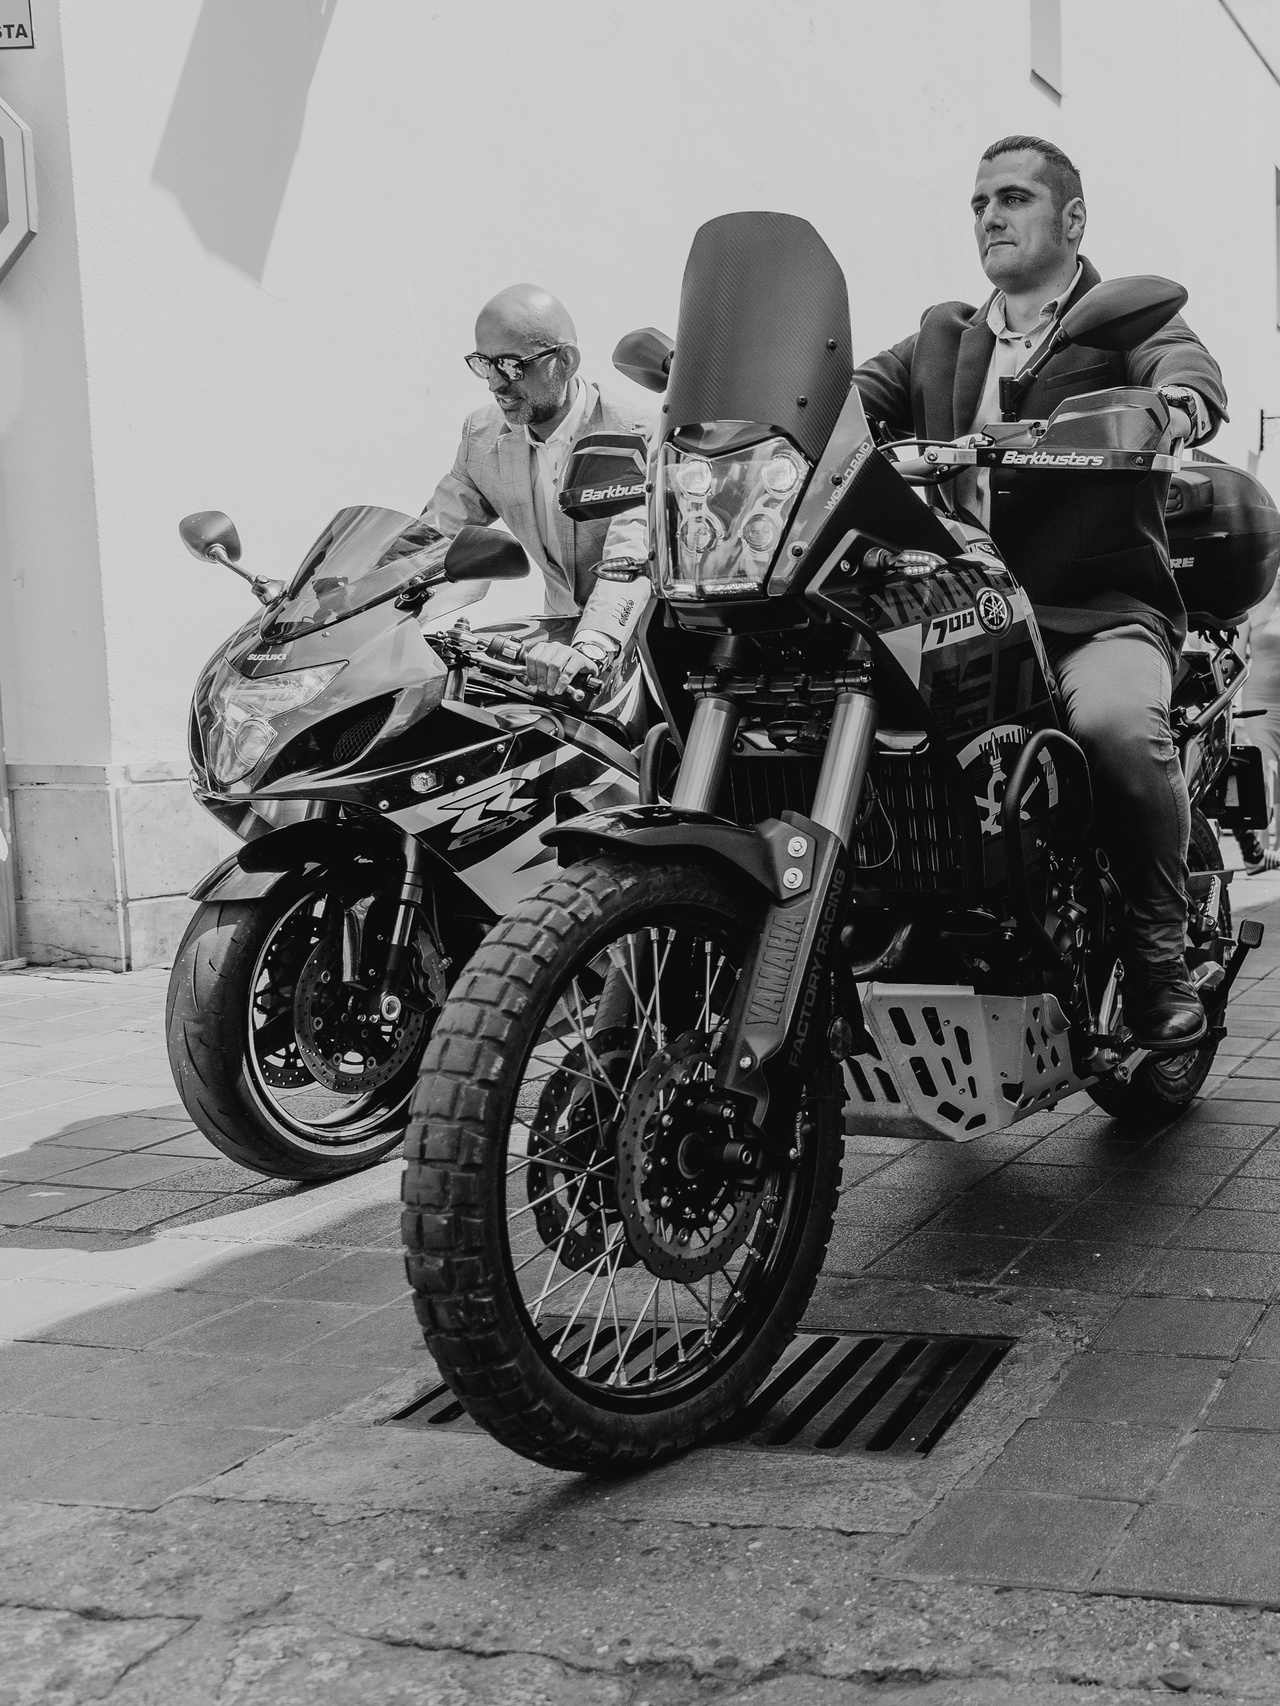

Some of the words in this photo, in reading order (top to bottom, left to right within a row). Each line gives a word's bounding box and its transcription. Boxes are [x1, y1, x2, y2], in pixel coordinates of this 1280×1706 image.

[1002, 450, 1104, 466] Barkbusters
[869, 565, 1018, 629] YAMAHA
[932, 611, 975, 645] 700
[246, 653, 287, 661] SUZUKI
[746, 915, 806, 1026] YAMAHA
[788, 956, 823, 1068] FACTORY
[815, 867, 847, 956] RACING
